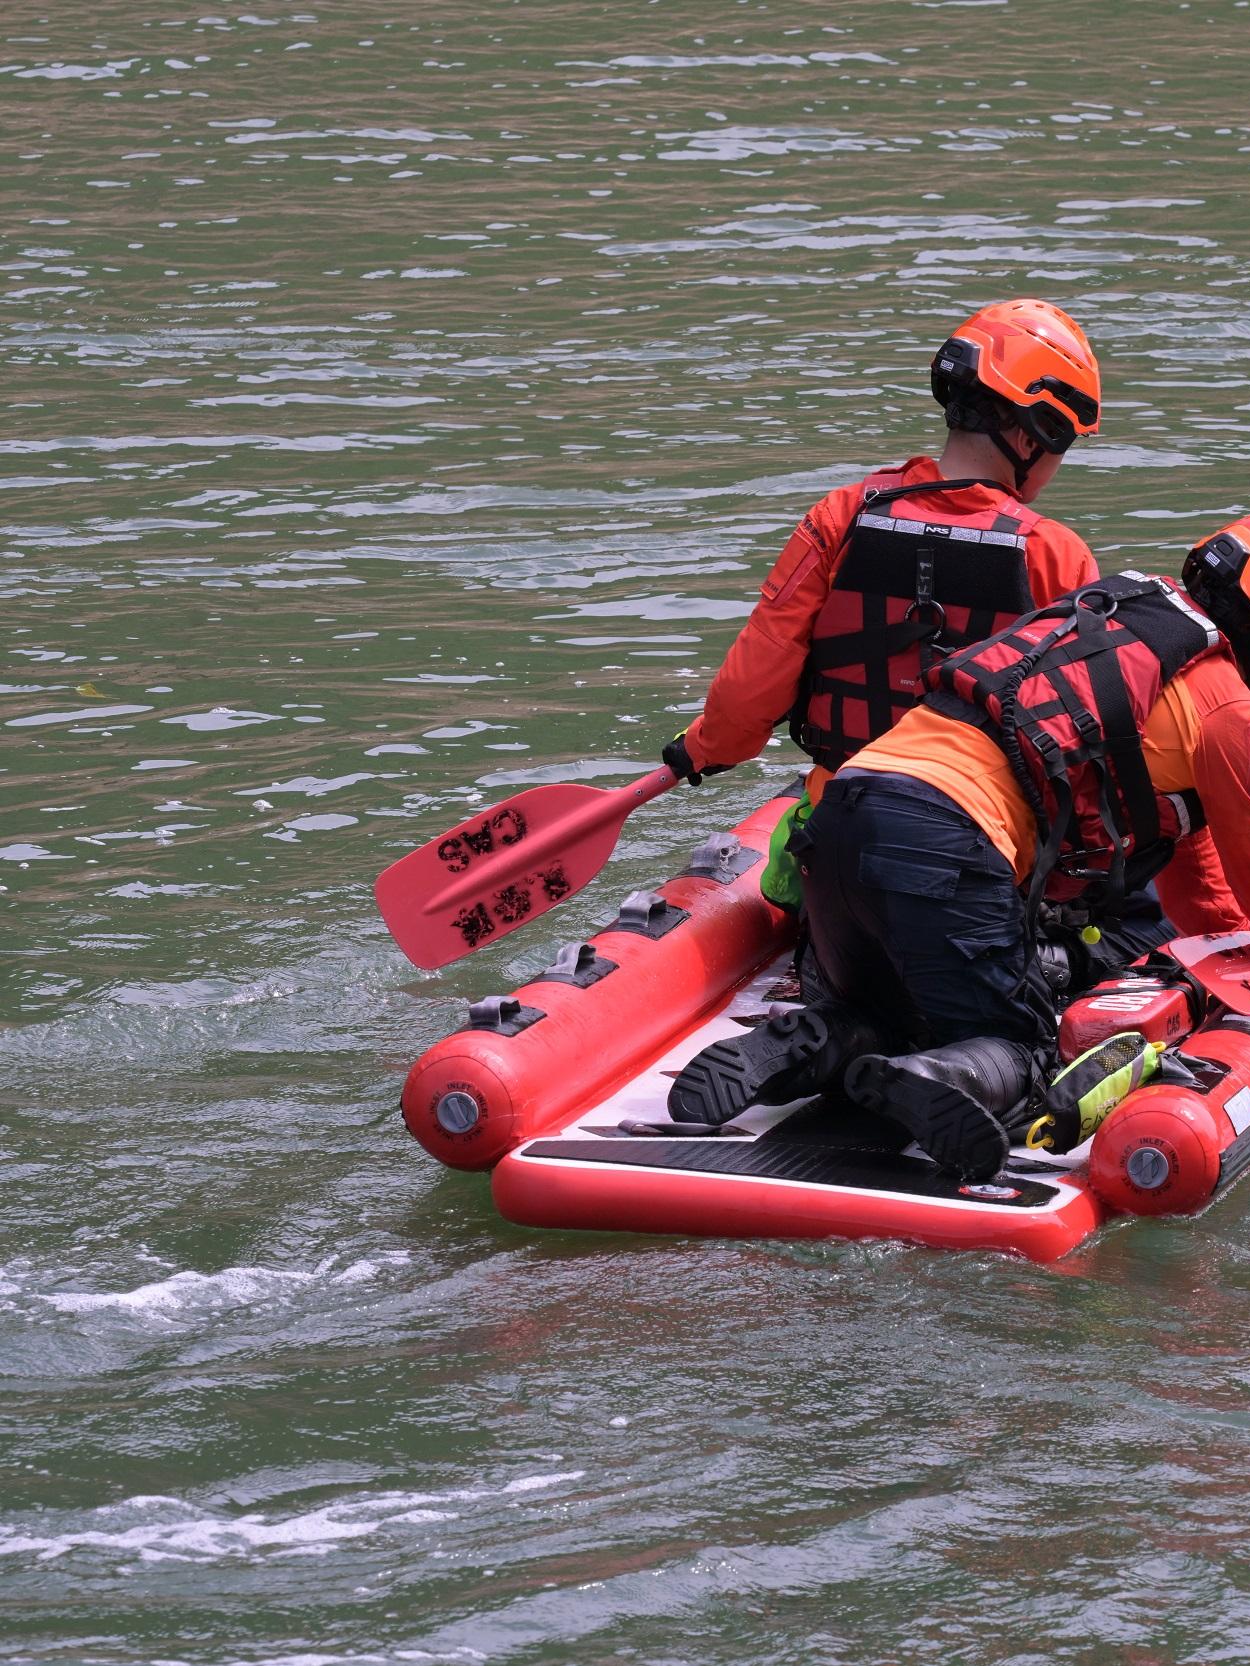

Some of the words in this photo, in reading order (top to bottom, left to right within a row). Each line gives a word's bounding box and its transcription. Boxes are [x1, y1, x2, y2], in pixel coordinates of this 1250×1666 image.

[925, 526, 949, 535] NRS
[437, 808, 528, 873] CAS
[447, 1082, 473, 1090] INLET
[1139, 1137, 1165, 1147] INLET
[1168, 1149, 1180, 1174] INLET
